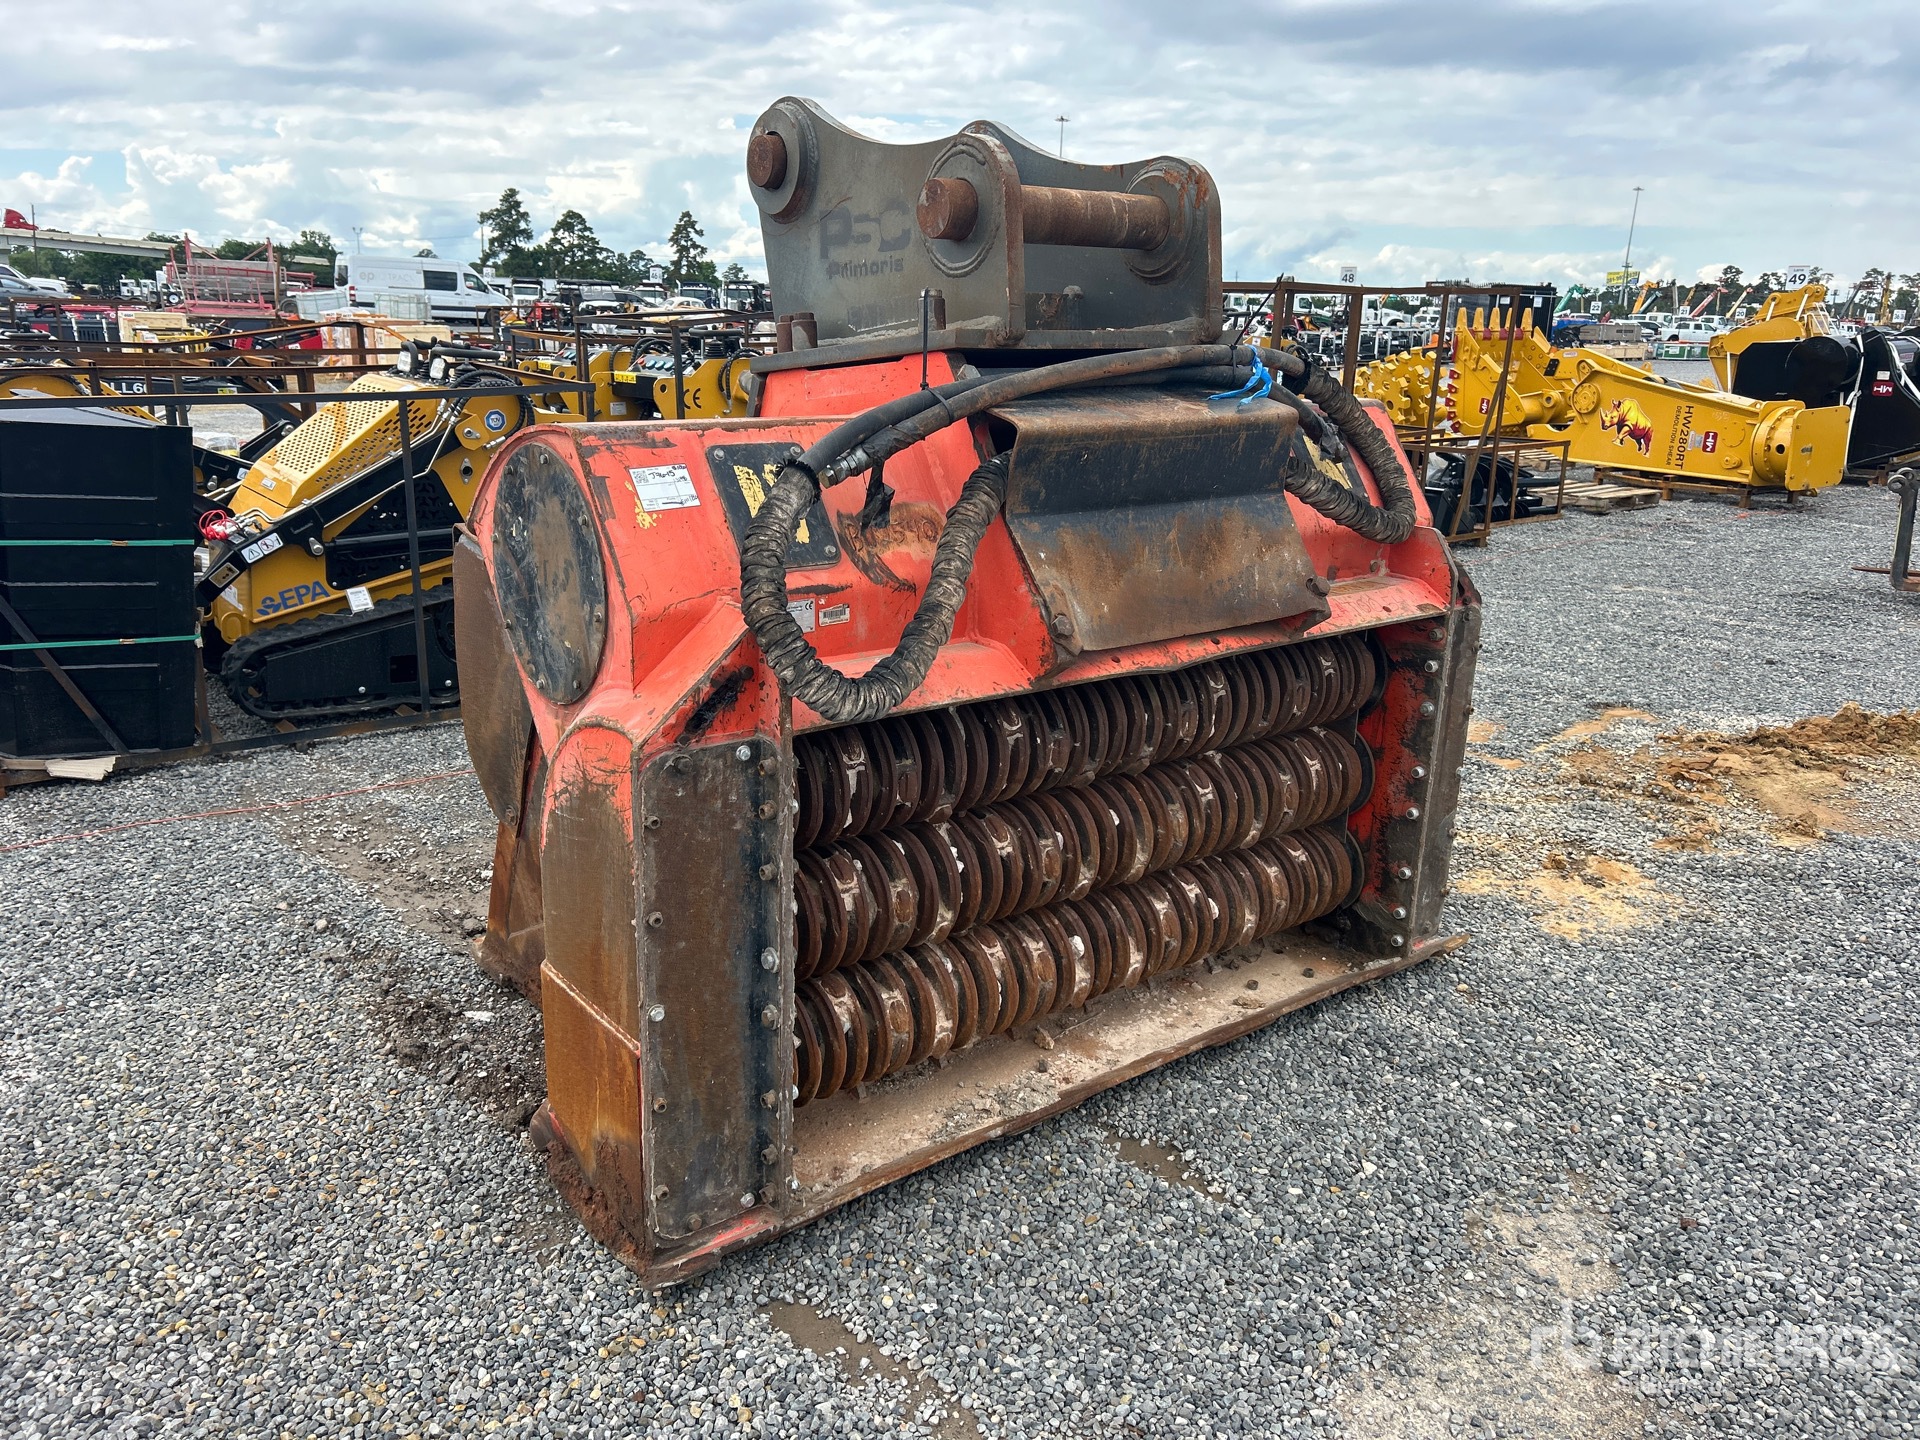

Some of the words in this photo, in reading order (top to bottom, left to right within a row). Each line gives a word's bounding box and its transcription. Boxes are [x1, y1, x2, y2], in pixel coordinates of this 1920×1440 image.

[1341, 273, 1354, 283] 48
[1788, 273, 1806, 284] 49
[1669, 405, 1683, 444] DEMOLITION
[1674, 405, 1695, 470] HW280RT
[1705, 432, 1715, 452] HW
[1665, 444, 1675, 466] SHEAR
[278, 580, 331, 610] EPA
